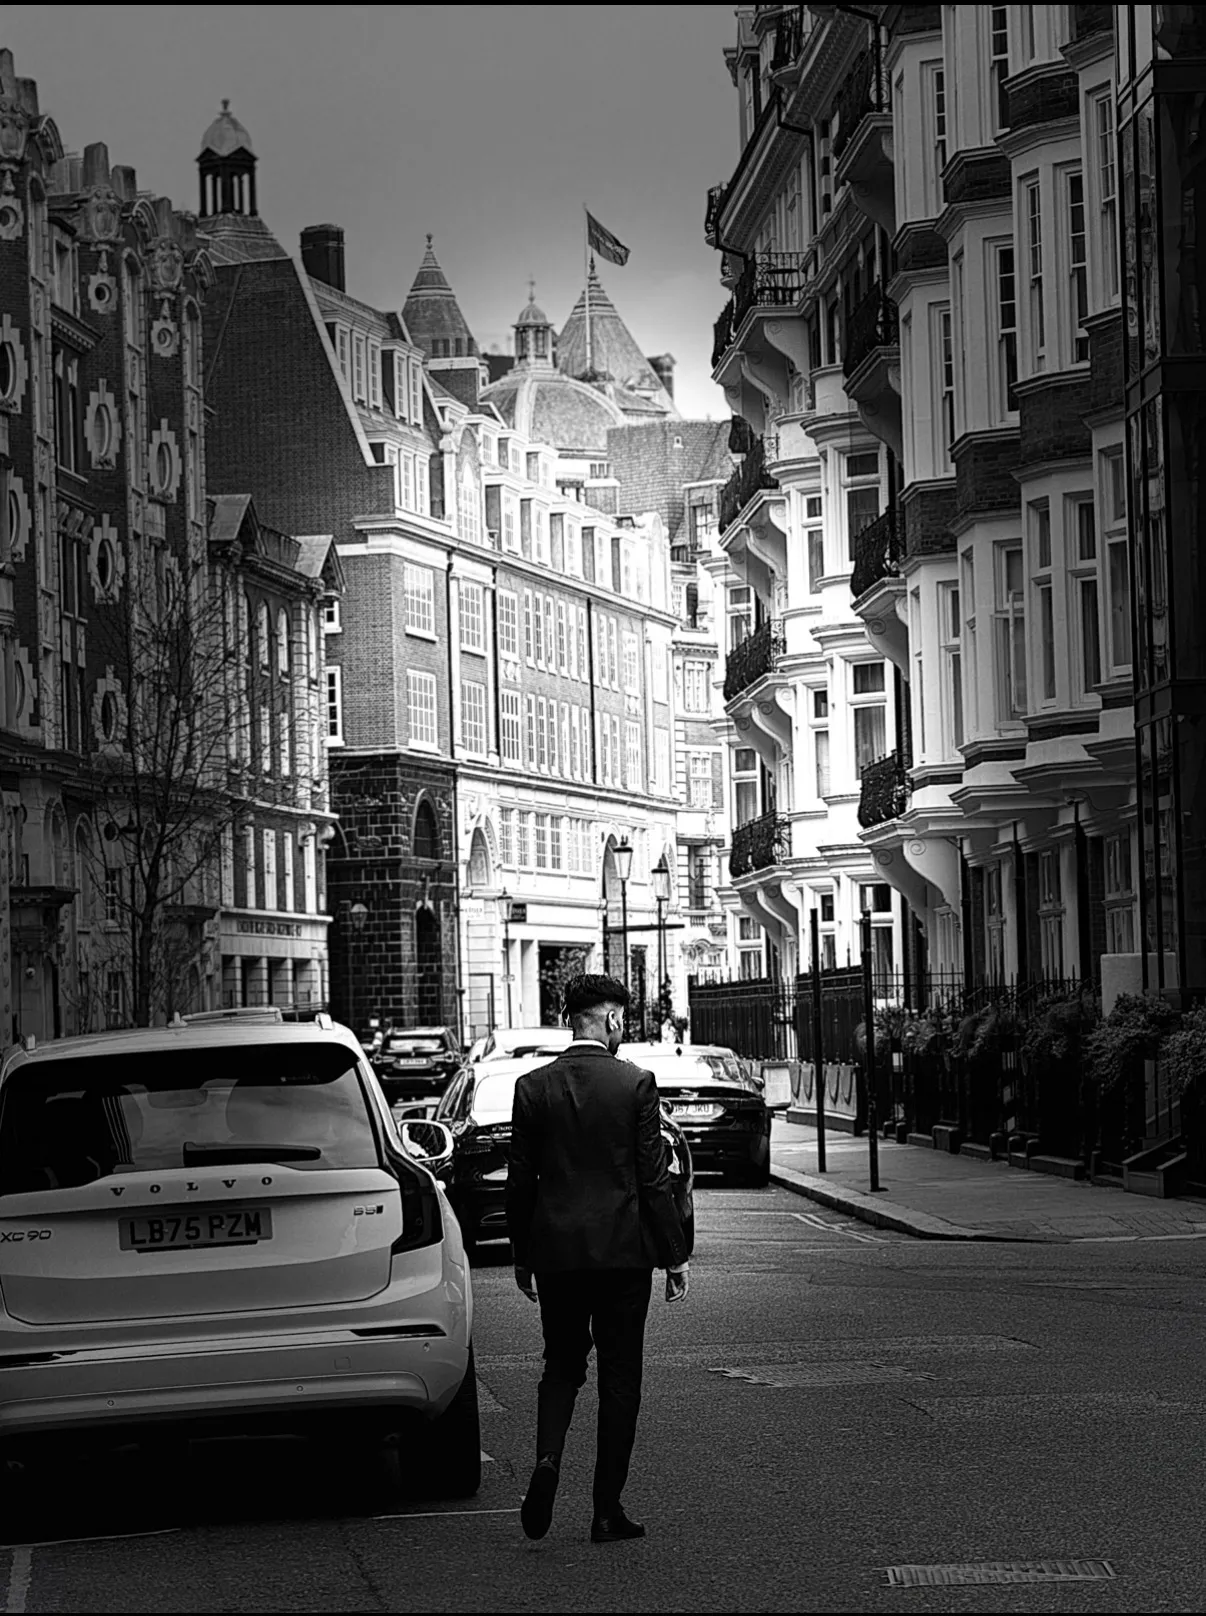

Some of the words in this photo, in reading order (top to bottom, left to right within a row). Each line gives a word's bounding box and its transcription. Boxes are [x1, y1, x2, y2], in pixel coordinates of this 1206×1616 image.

[110, 1176, 273, 1197] VOLVO
[129, 1216, 201, 1245] LB75
[208, 1211, 262, 1239] PZM
